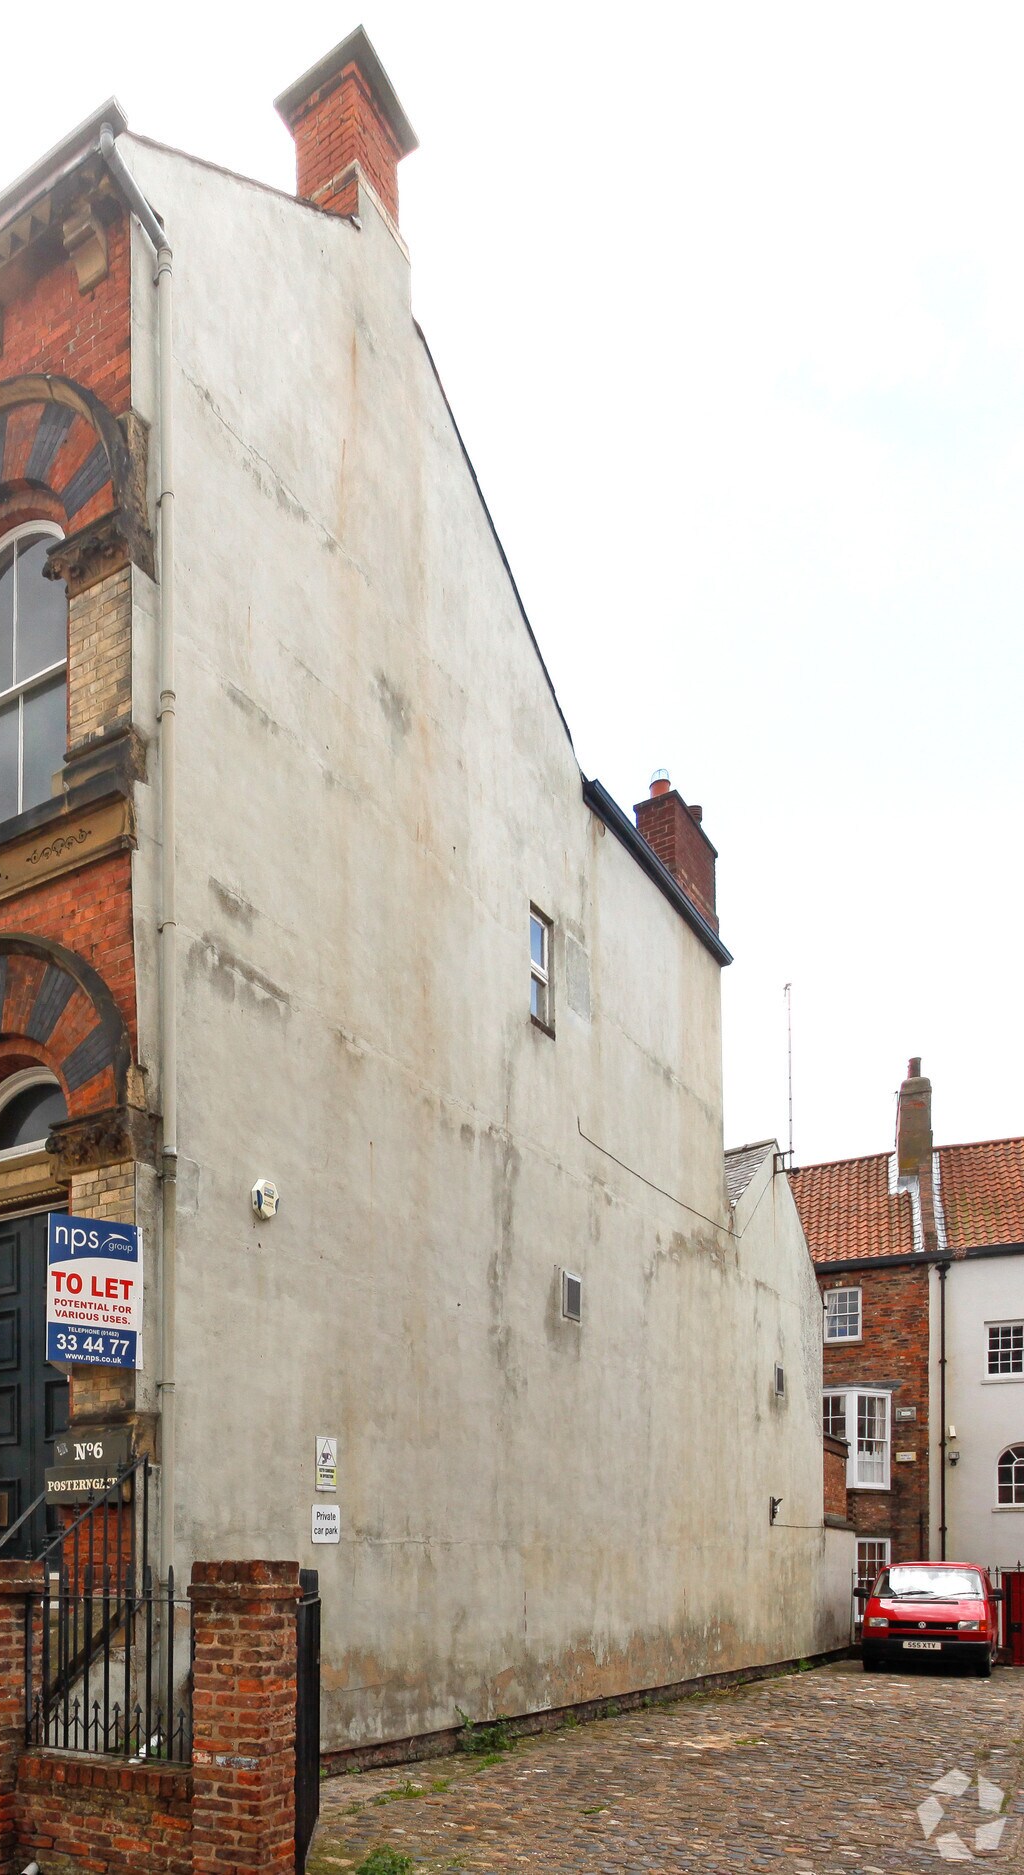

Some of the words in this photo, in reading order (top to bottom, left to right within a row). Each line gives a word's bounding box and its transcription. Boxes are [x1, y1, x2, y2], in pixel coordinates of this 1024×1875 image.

[56, 1226, 98, 1254] nps
[108, 1242, 133, 1254] group
[52, 1270, 83, 1294] TO
[92, 1276, 133, 1300] LET
[54, 1298, 109, 1312] POTENTIAL
[112, 1305, 132, 1314] FOR
[54, 1309, 99, 1321] VARIOUS
[102, 1315, 130, 1324] USES.
[68, 1327, 100, 1336] TELEPHONE
[56, 1334, 77, 1351] 33
[83, 1337, 104, 1353] 44
[110, 1339, 130, 1355] 77
[65, 1353, 122, 1364] www.nps.co.uk
[316, 1512, 336, 1520] Private
[325, 1526, 338, 1536] park
